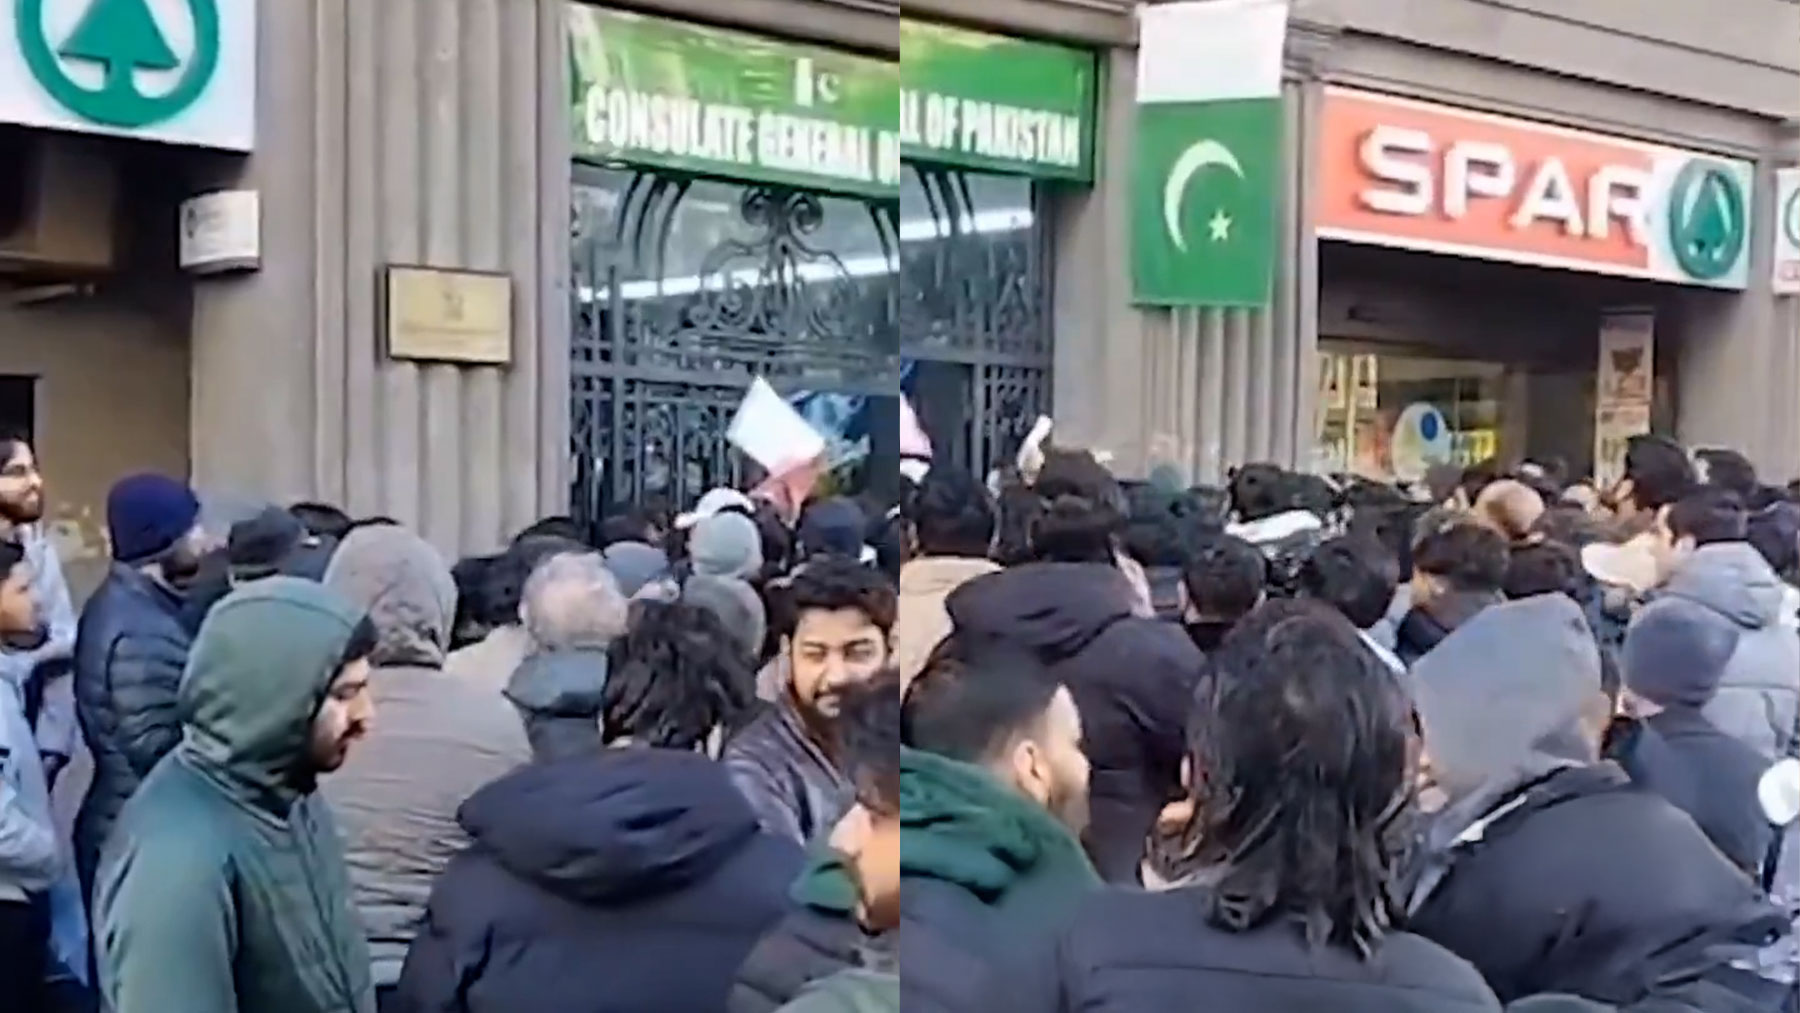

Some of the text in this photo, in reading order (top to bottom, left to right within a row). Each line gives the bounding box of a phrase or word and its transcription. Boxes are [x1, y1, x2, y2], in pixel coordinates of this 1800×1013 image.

[587, 84, 754, 164] CONSULATE
[757, 110, 872, 181] GENERAL
[926, 92, 958, 149] OF
[961, 99, 1080, 167] PAKISTAN
[1359, 123, 1653, 246] SPAR
